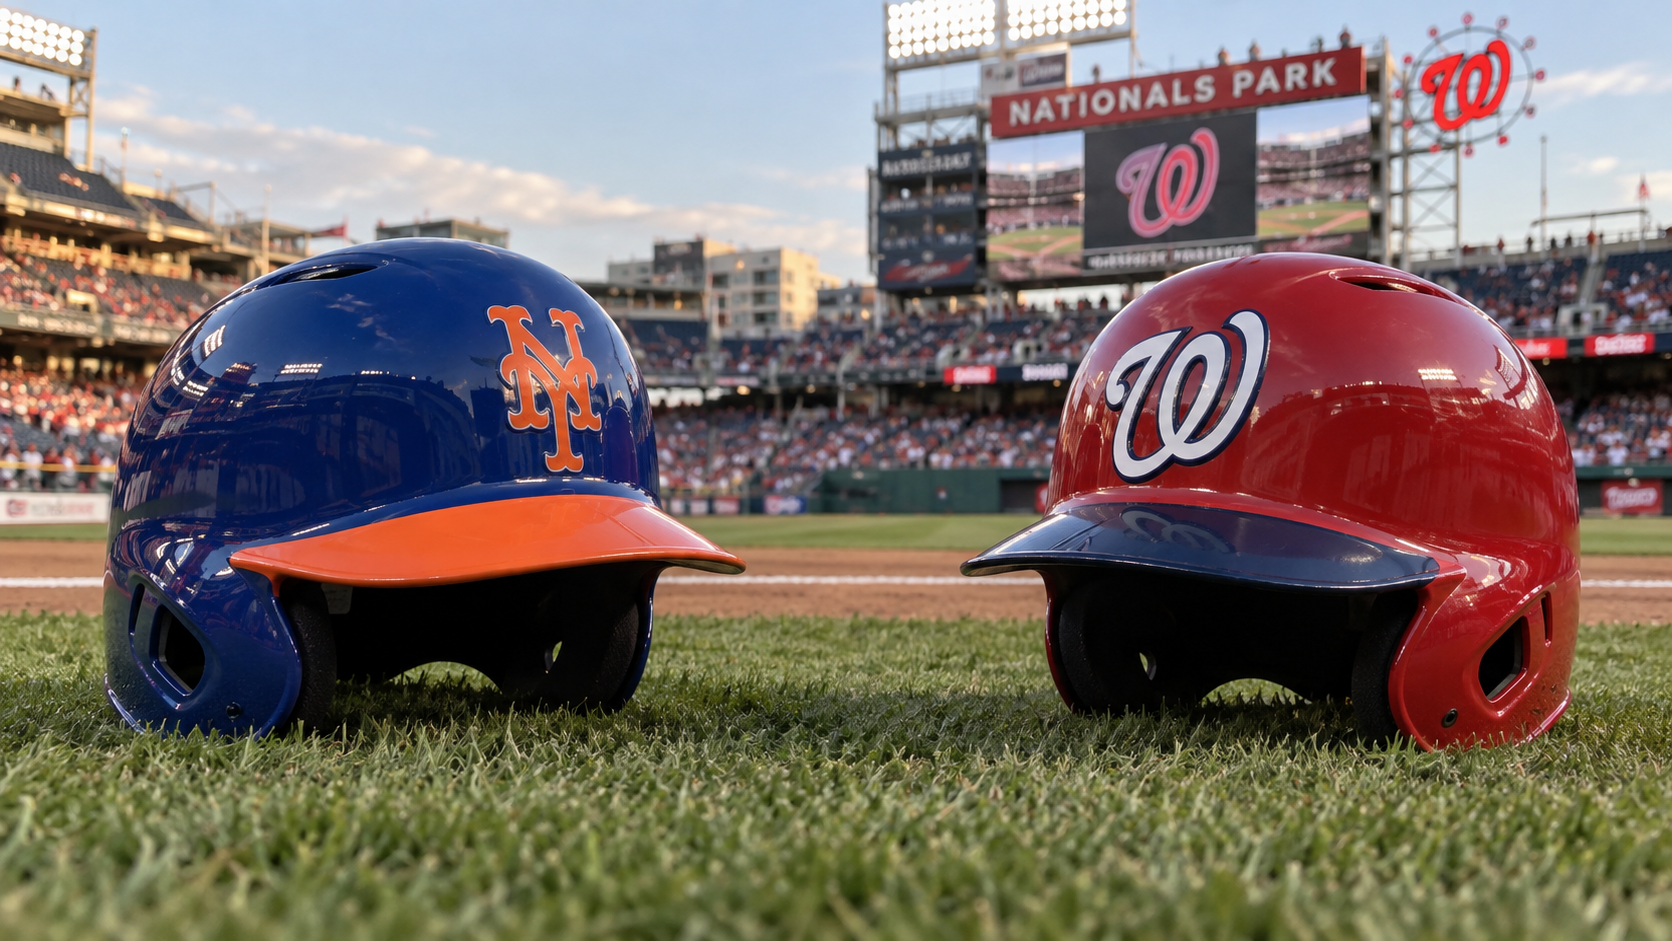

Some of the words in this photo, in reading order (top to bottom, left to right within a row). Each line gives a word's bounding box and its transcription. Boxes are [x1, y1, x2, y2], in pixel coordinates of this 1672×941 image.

[1009, 75, 1216, 127] NATIONALS
[1232, 57, 1337, 99] PARK
[1420, 39, 1511, 131] W
[1115, 127, 1220, 238] W
[1105, 309, 1270, 484] W
